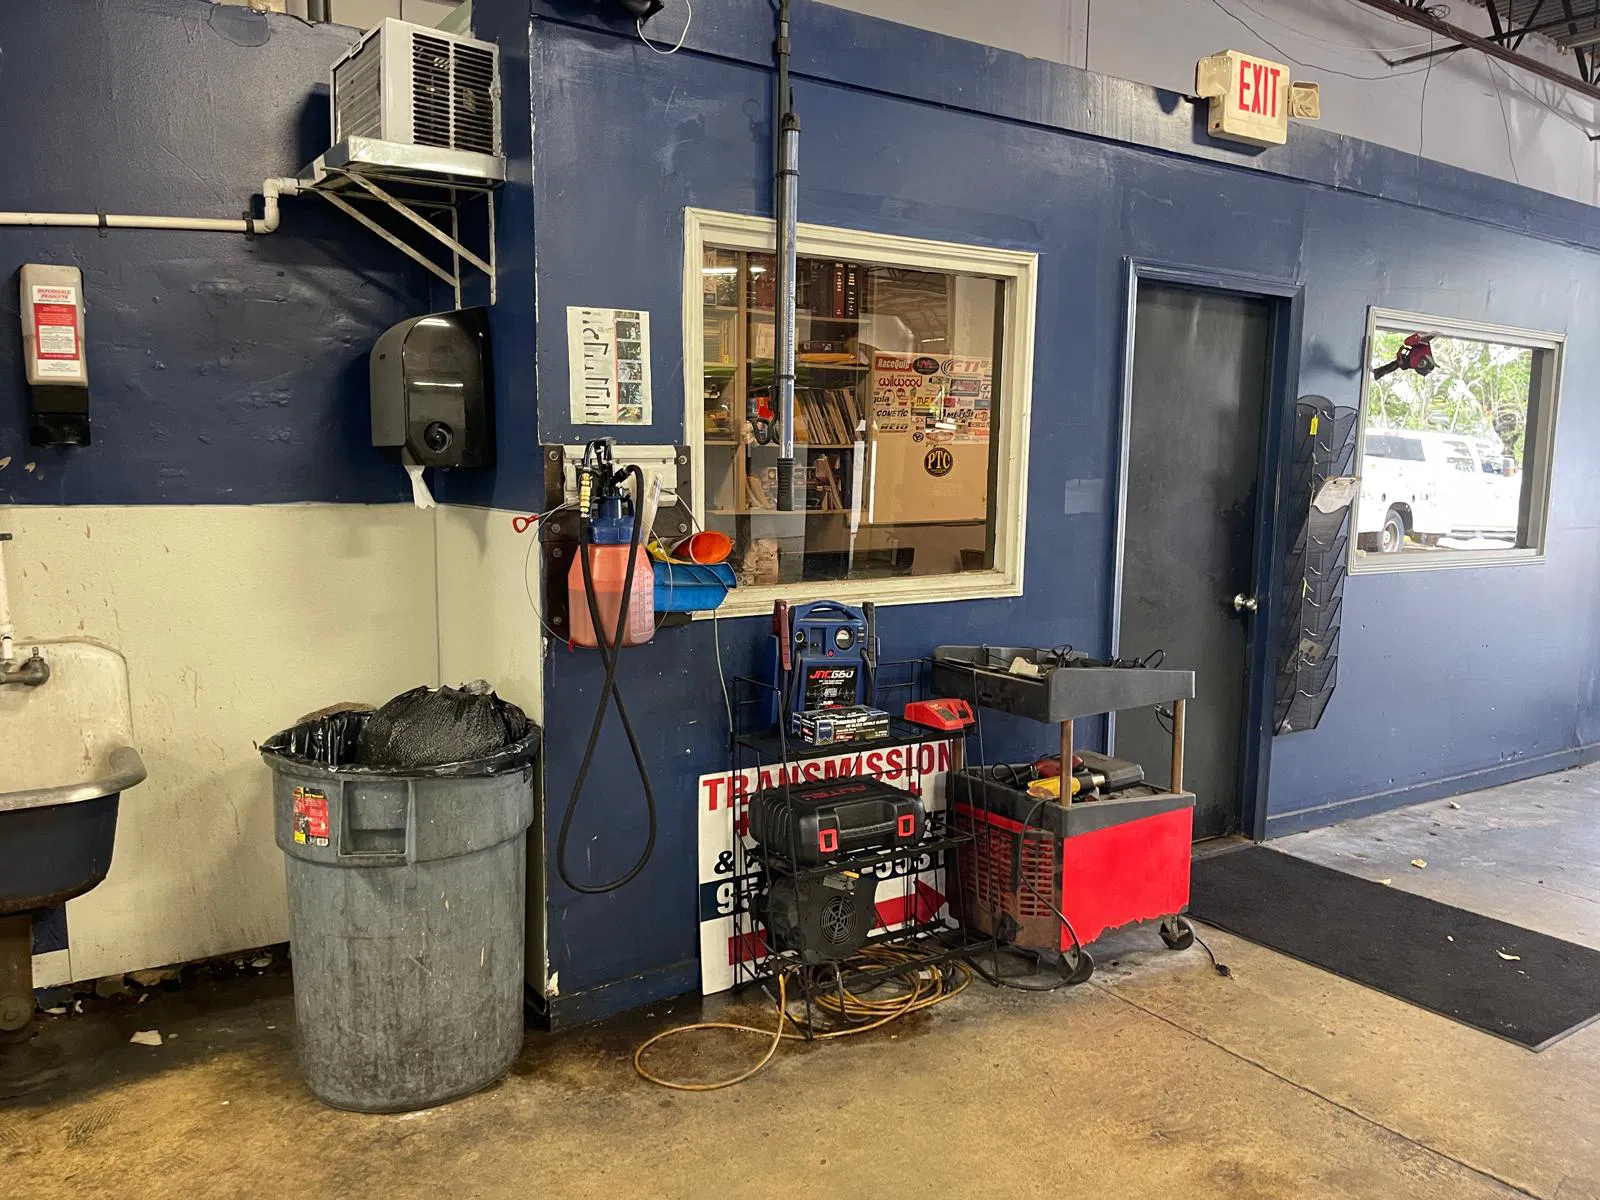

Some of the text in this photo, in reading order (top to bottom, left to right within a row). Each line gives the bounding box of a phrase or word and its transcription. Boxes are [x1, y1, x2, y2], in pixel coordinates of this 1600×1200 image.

[1239, 60, 1280, 118] EXIT
[877, 359, 910, 369] RaceQuip
[879, 375, 923, 388] wilwood
[928, 450, 951, 469] PTC
